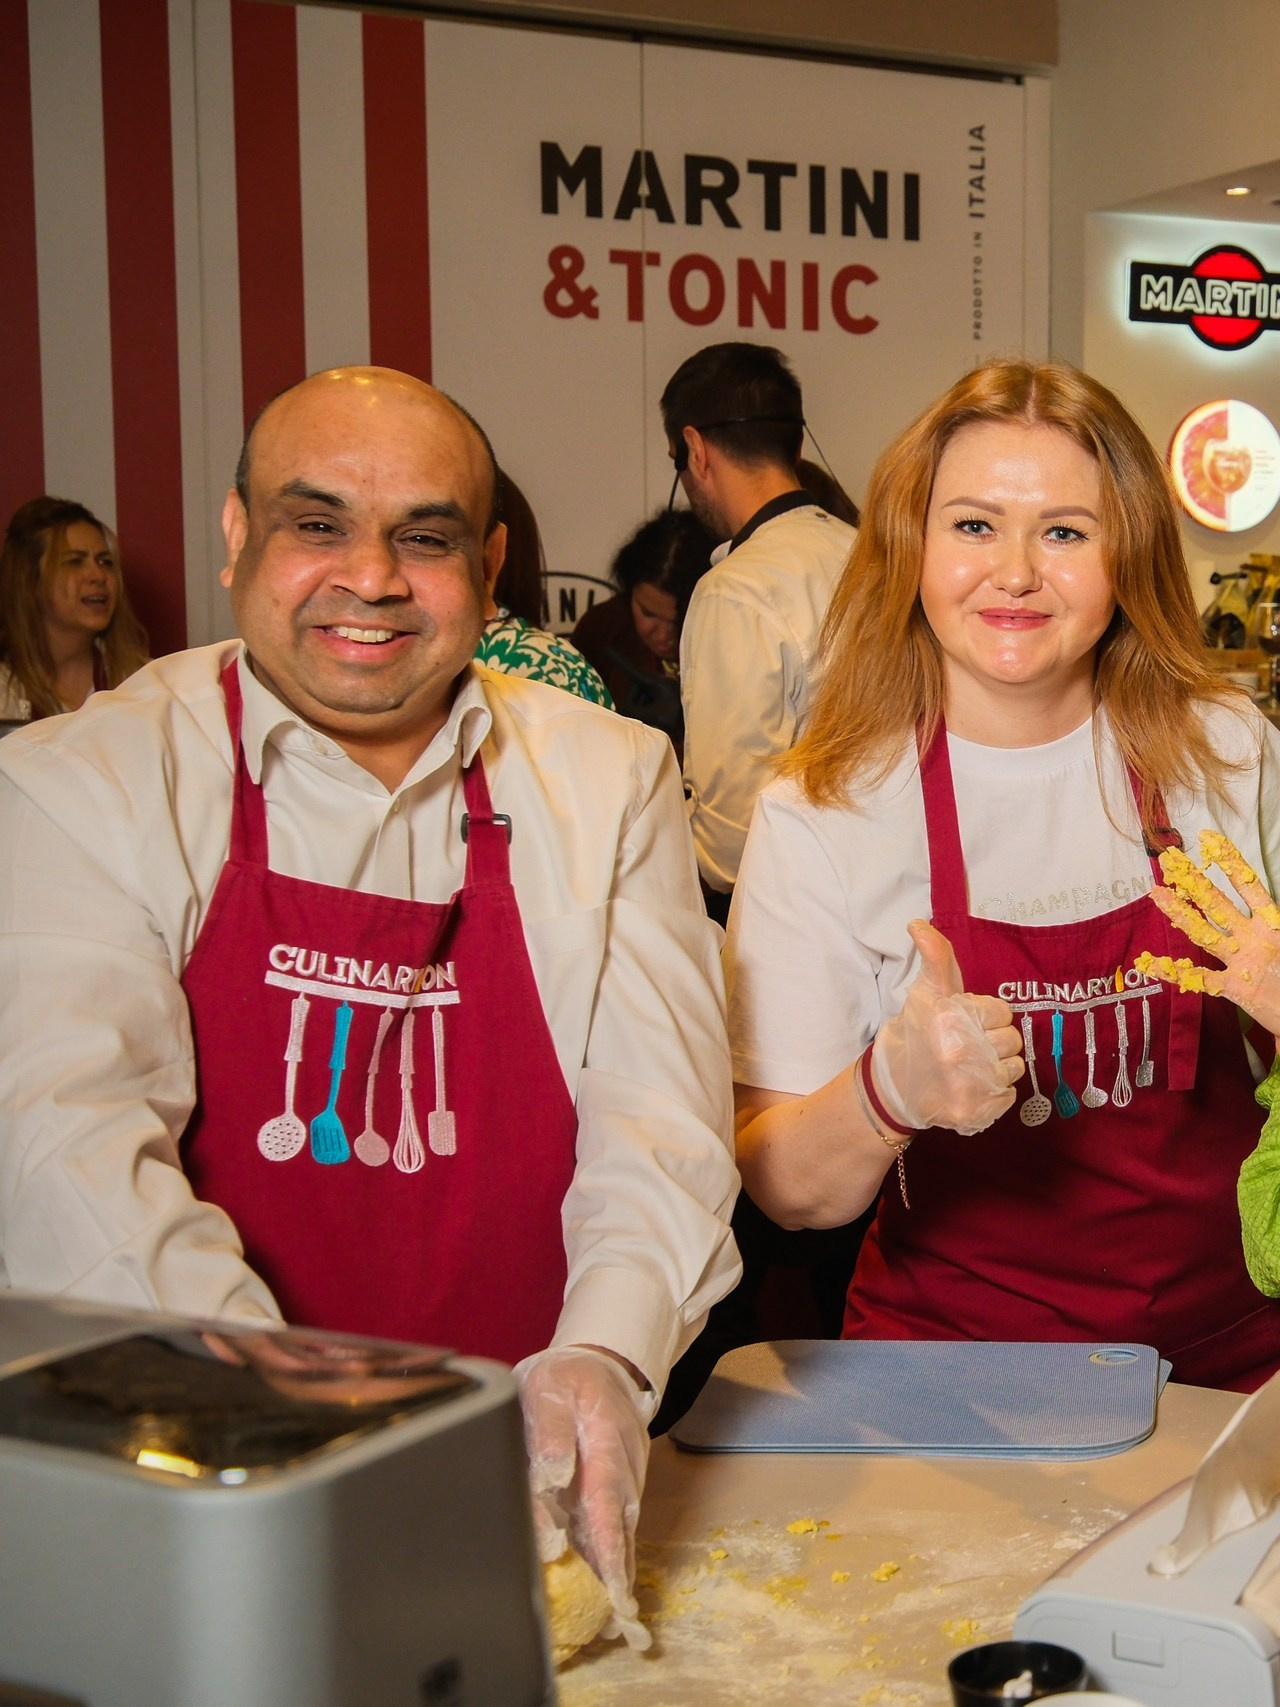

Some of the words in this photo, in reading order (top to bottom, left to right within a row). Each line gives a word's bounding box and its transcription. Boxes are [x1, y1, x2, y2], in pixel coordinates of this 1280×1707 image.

[540, 140, 921, 241] MARTINI
[968, 123, 987, 219] ITALIA
[972, 231, 984, 248] IN
[542, 244, 880, 335] &TONIC
[972, 255, 984, 341] PRODOTTO
[977, 875, 1153, 921] CHAMPAGN
